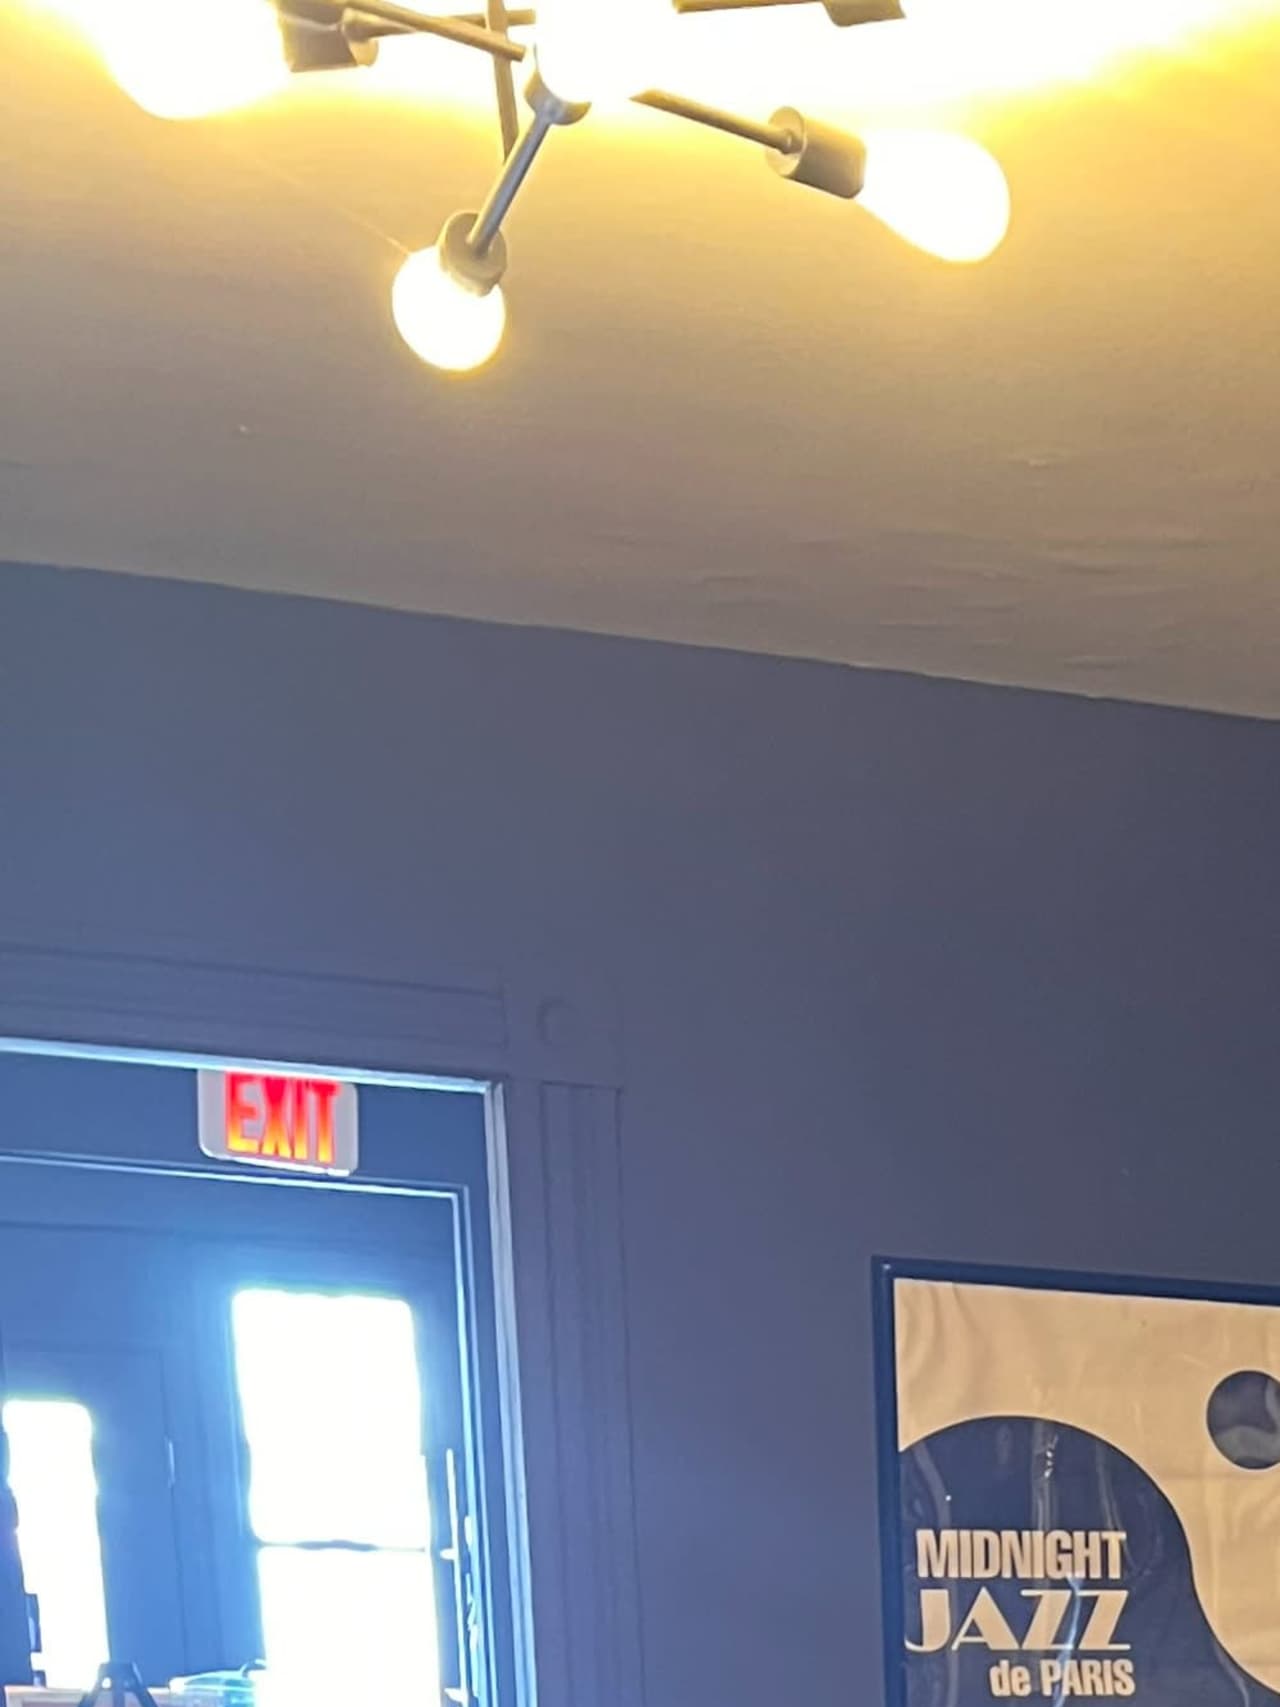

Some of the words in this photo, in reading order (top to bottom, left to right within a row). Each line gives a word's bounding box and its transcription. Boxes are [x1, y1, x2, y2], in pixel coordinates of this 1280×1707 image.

[224, 1071, 341, 1164] EXIT
[916, 1528, 1127, 1579] MIDNIGHT
[904, 1586, 1131, 1652] JAZZ
[989, 1659, 1032, 1696] de
[1039, 1658, 1136, 1696] PARIS
